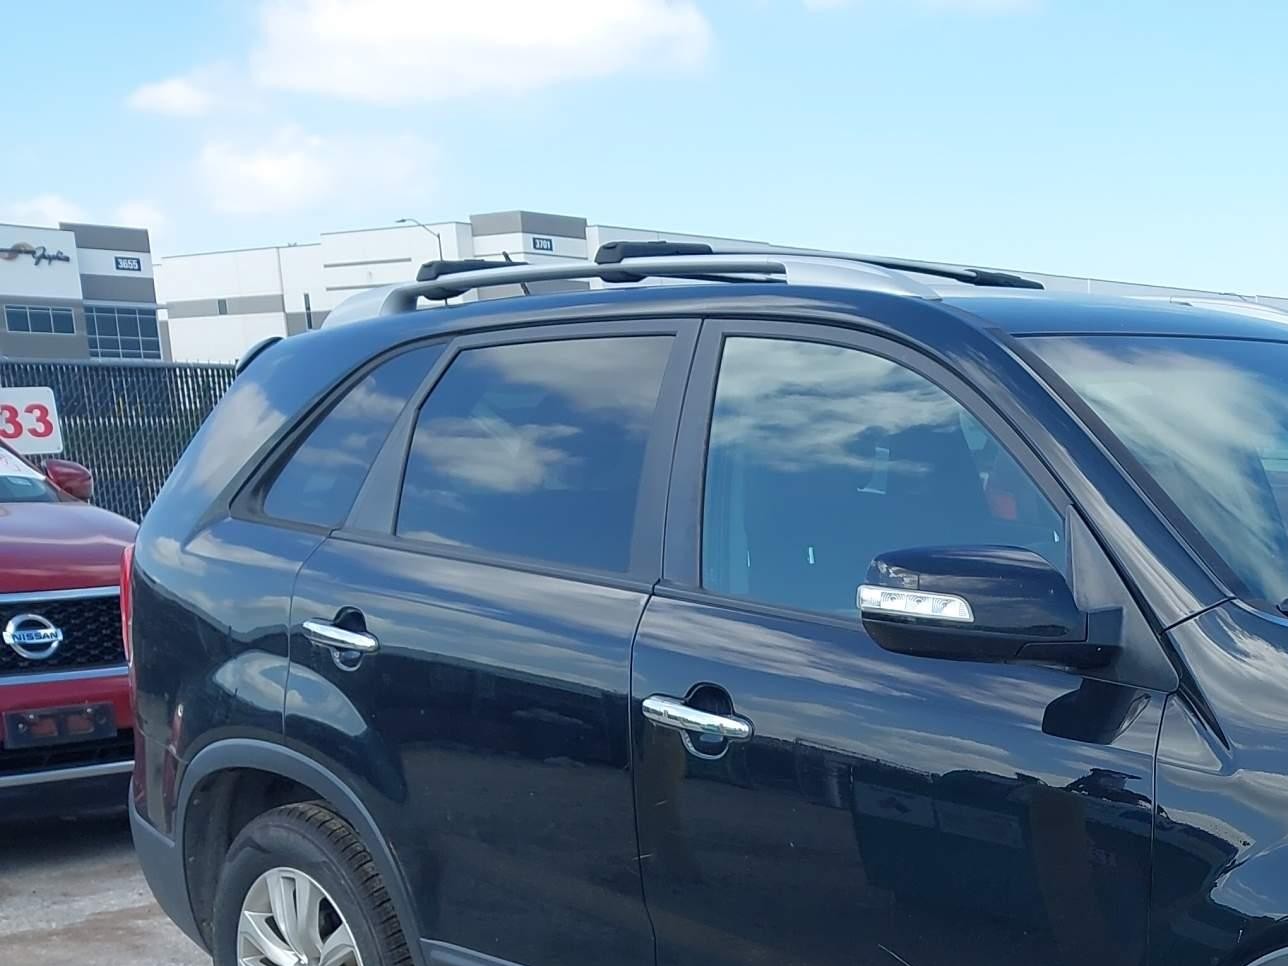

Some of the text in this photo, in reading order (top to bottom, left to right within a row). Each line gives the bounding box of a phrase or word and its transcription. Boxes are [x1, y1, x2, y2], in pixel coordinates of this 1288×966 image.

[117, 258, 139, 270] 3655
[0, 404, 54, 439] 33
[12, 631, 58, 641] NISSAN
